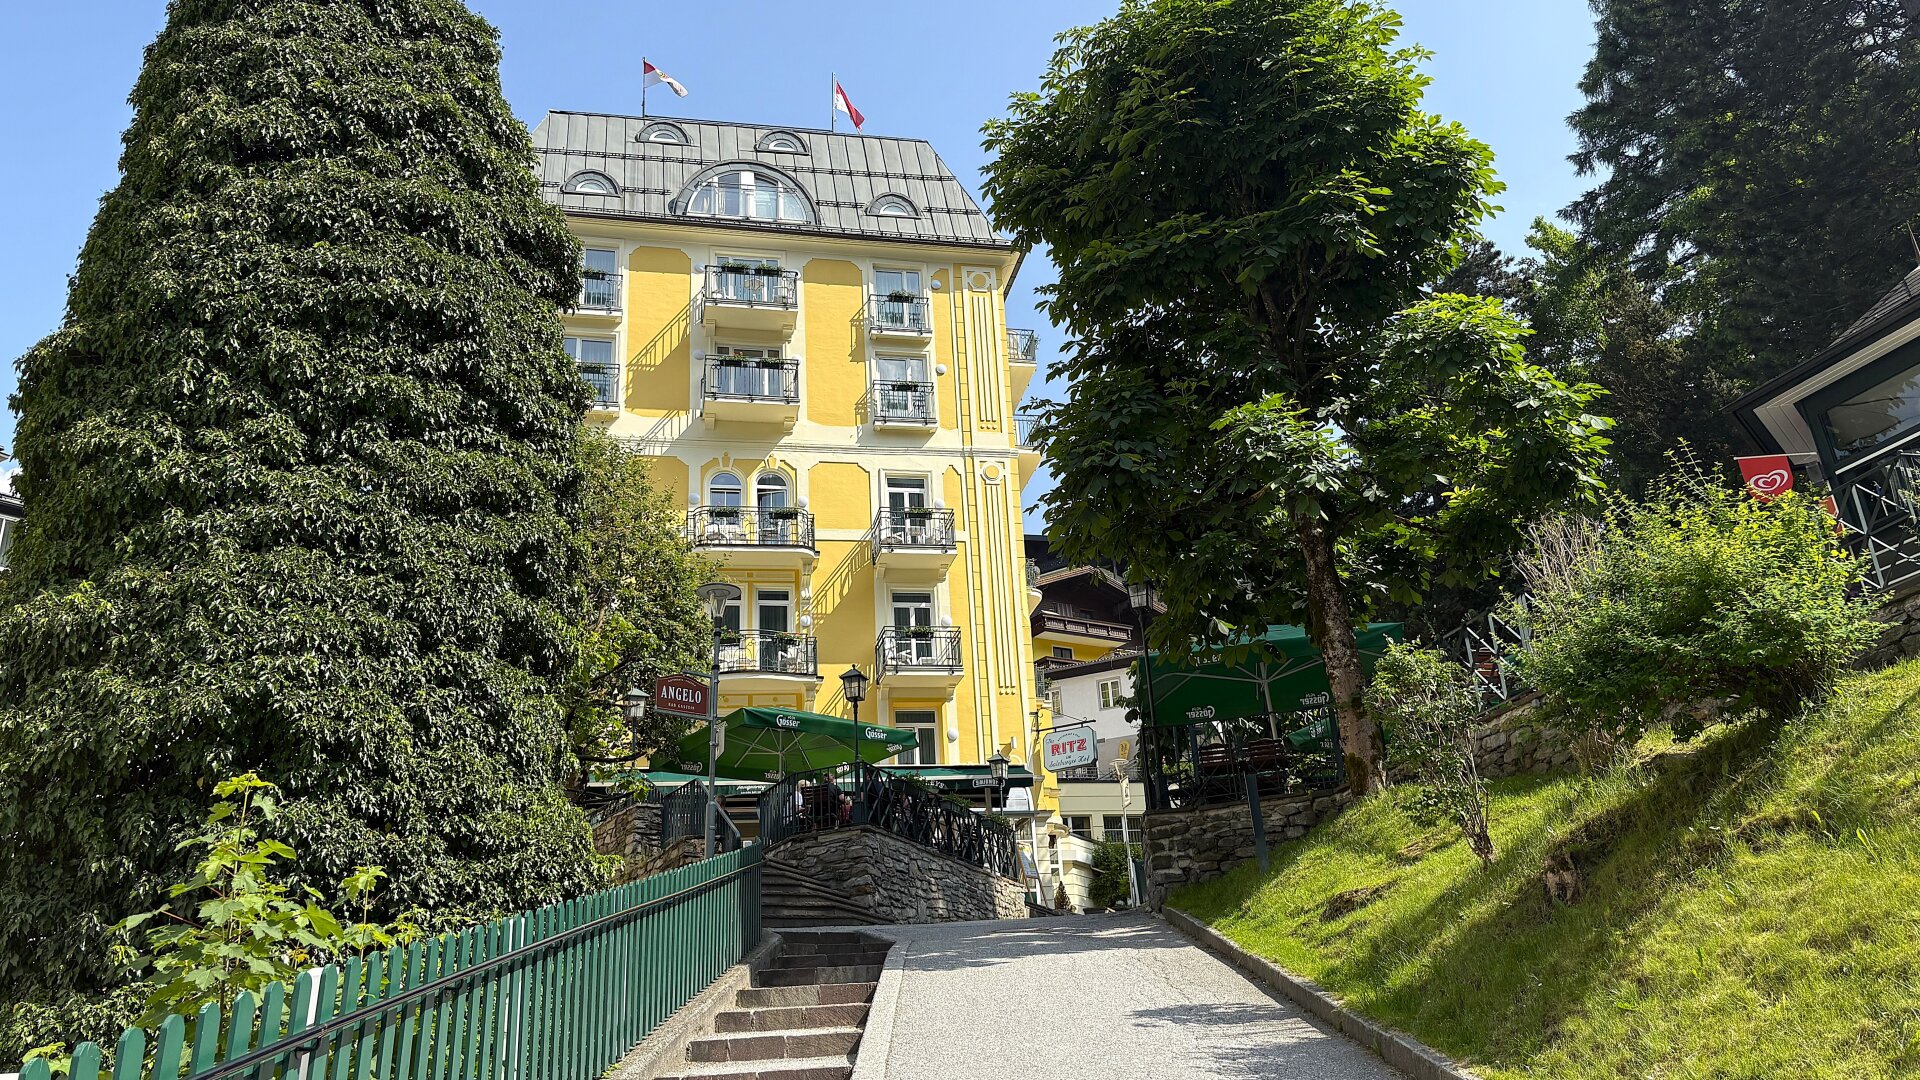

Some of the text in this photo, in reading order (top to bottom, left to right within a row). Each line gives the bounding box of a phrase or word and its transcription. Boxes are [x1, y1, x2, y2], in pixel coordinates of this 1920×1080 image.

[661, 685, 702, 703] ANGELO
[776, 714, 800, 727] Gösser
[865, 727, 887, 740] Gösser
[1051, 738, 1087, 756] RITZ
